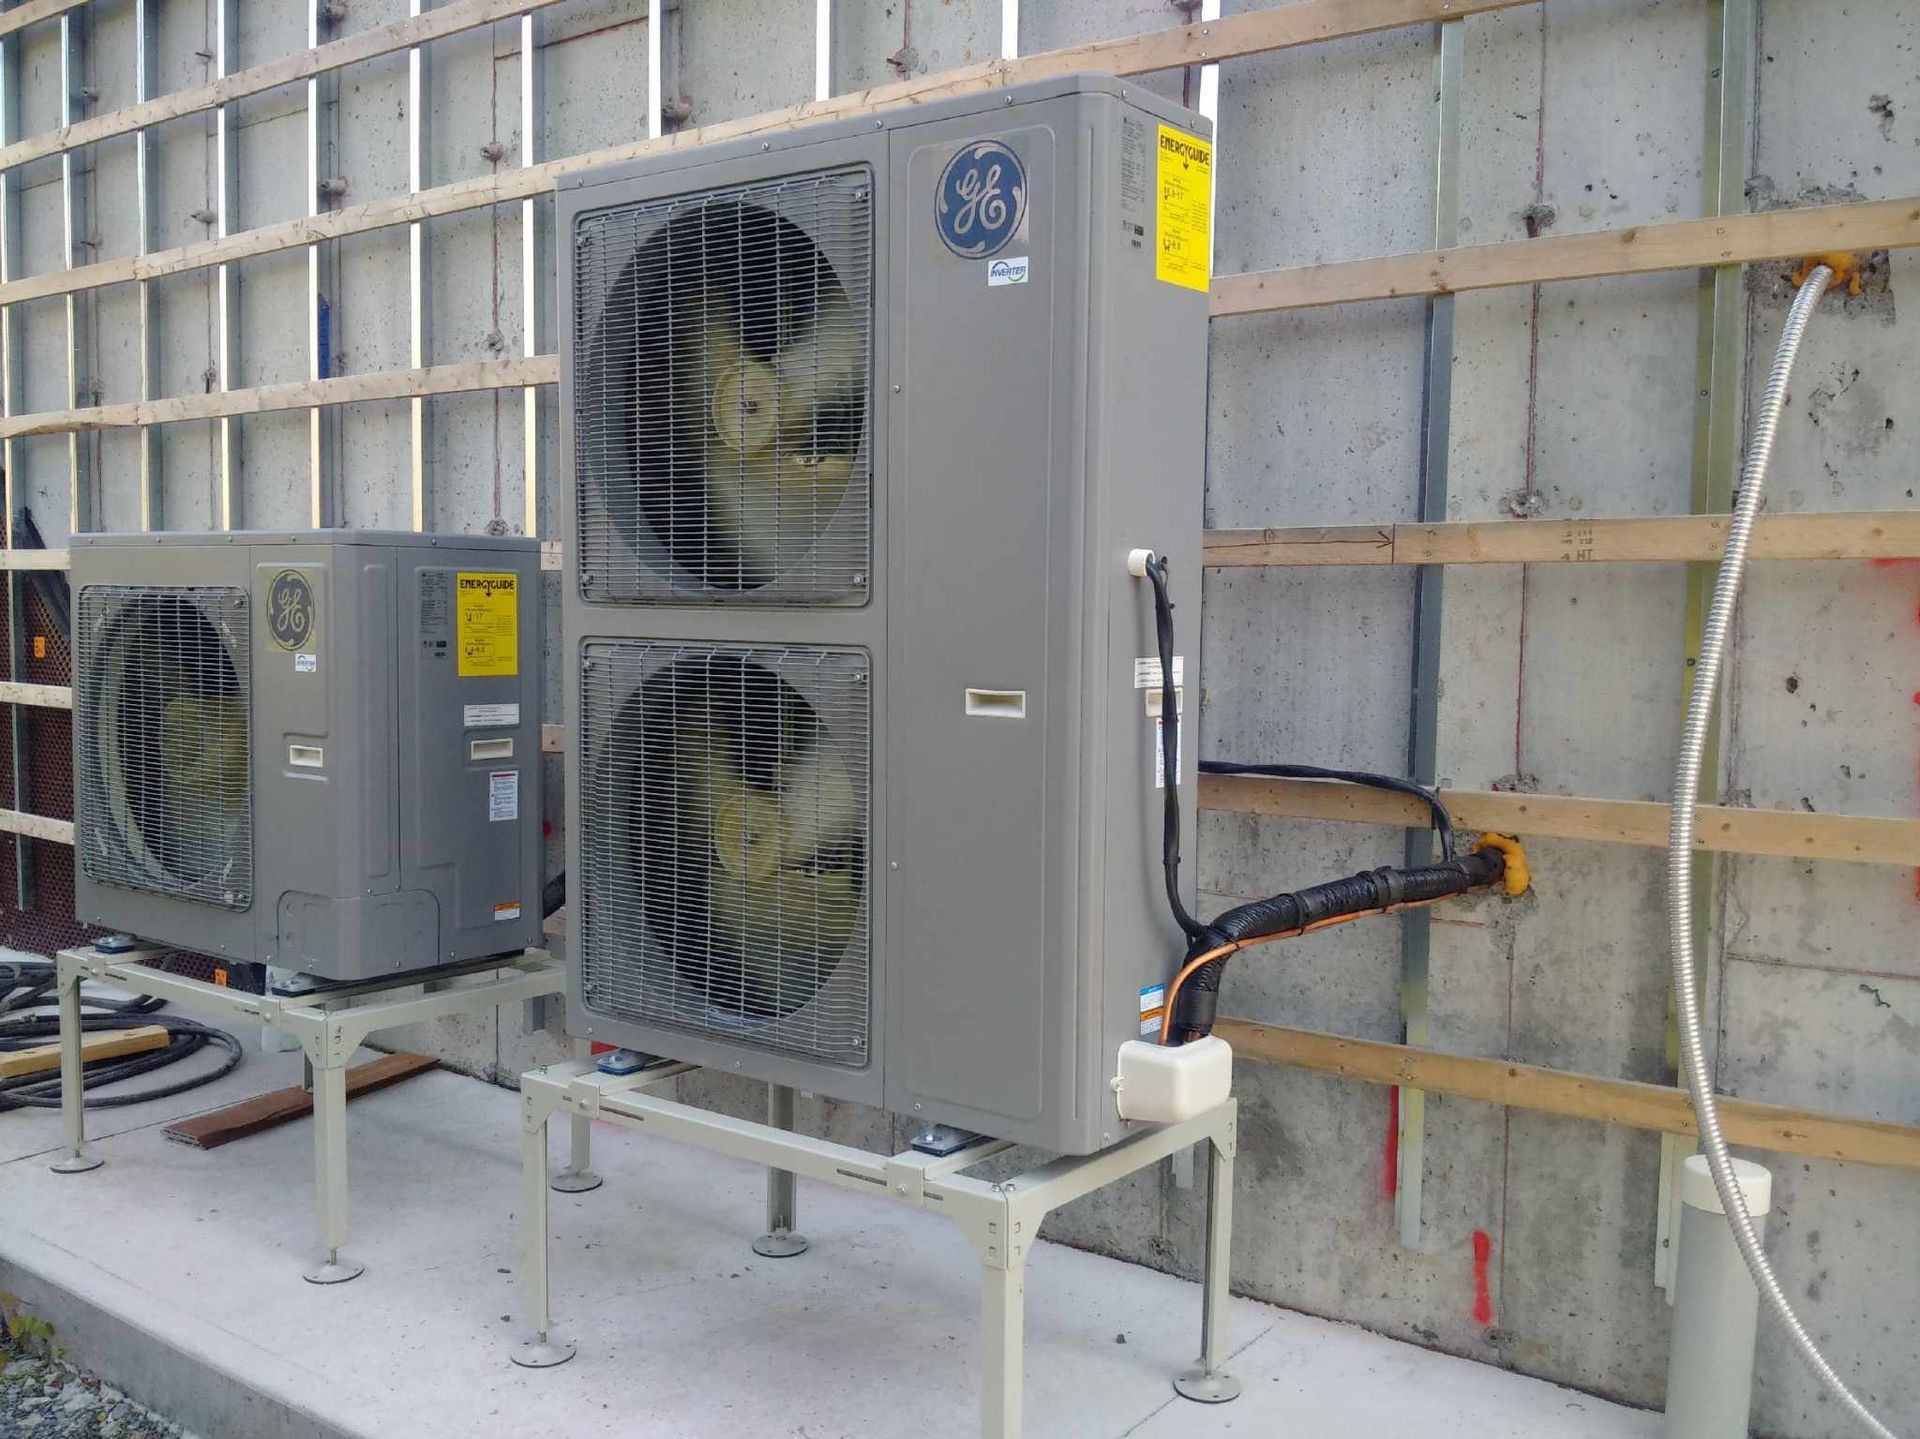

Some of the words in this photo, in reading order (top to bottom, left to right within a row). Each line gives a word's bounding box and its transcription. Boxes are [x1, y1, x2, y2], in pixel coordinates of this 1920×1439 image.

[1160, 134, 1210, 166] ENERGYGUIDE
[990, 265, 1026, 277] INVERTER
[460, 579, 515, 590] ENERGYGUIDE
